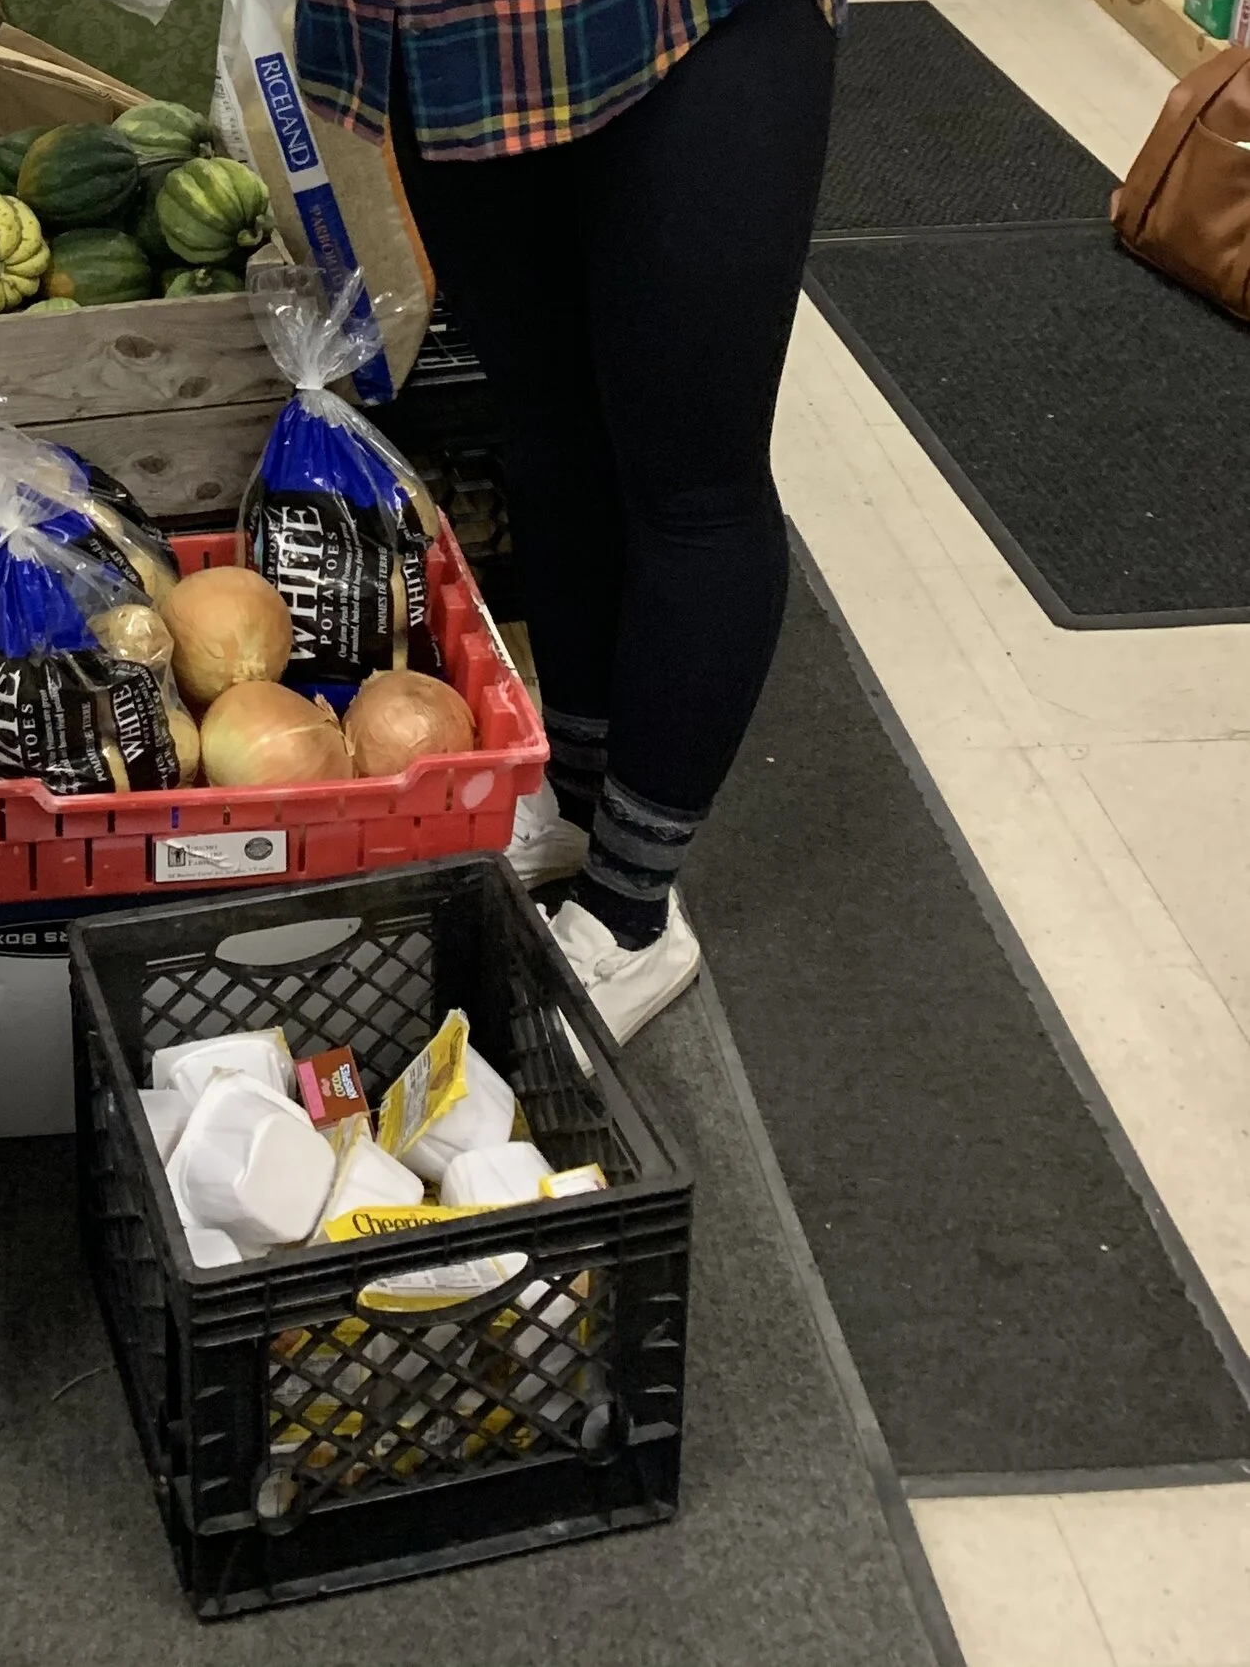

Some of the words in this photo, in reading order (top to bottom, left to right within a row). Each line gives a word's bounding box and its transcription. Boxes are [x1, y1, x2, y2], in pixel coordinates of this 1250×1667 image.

[261, 58, 311, 166] RICELAND
[276, 505, 324, 661] WHITE
[320, 531, 340, 645] POTATOES
[402, 550, 425, 627] WHITE
[21, 703, 42, 771] ATOES
[87, 742, 107, 782] POMME
[113, 684, 145, 764] WHITE
[331, 1070, 346, 1097] COCOA
